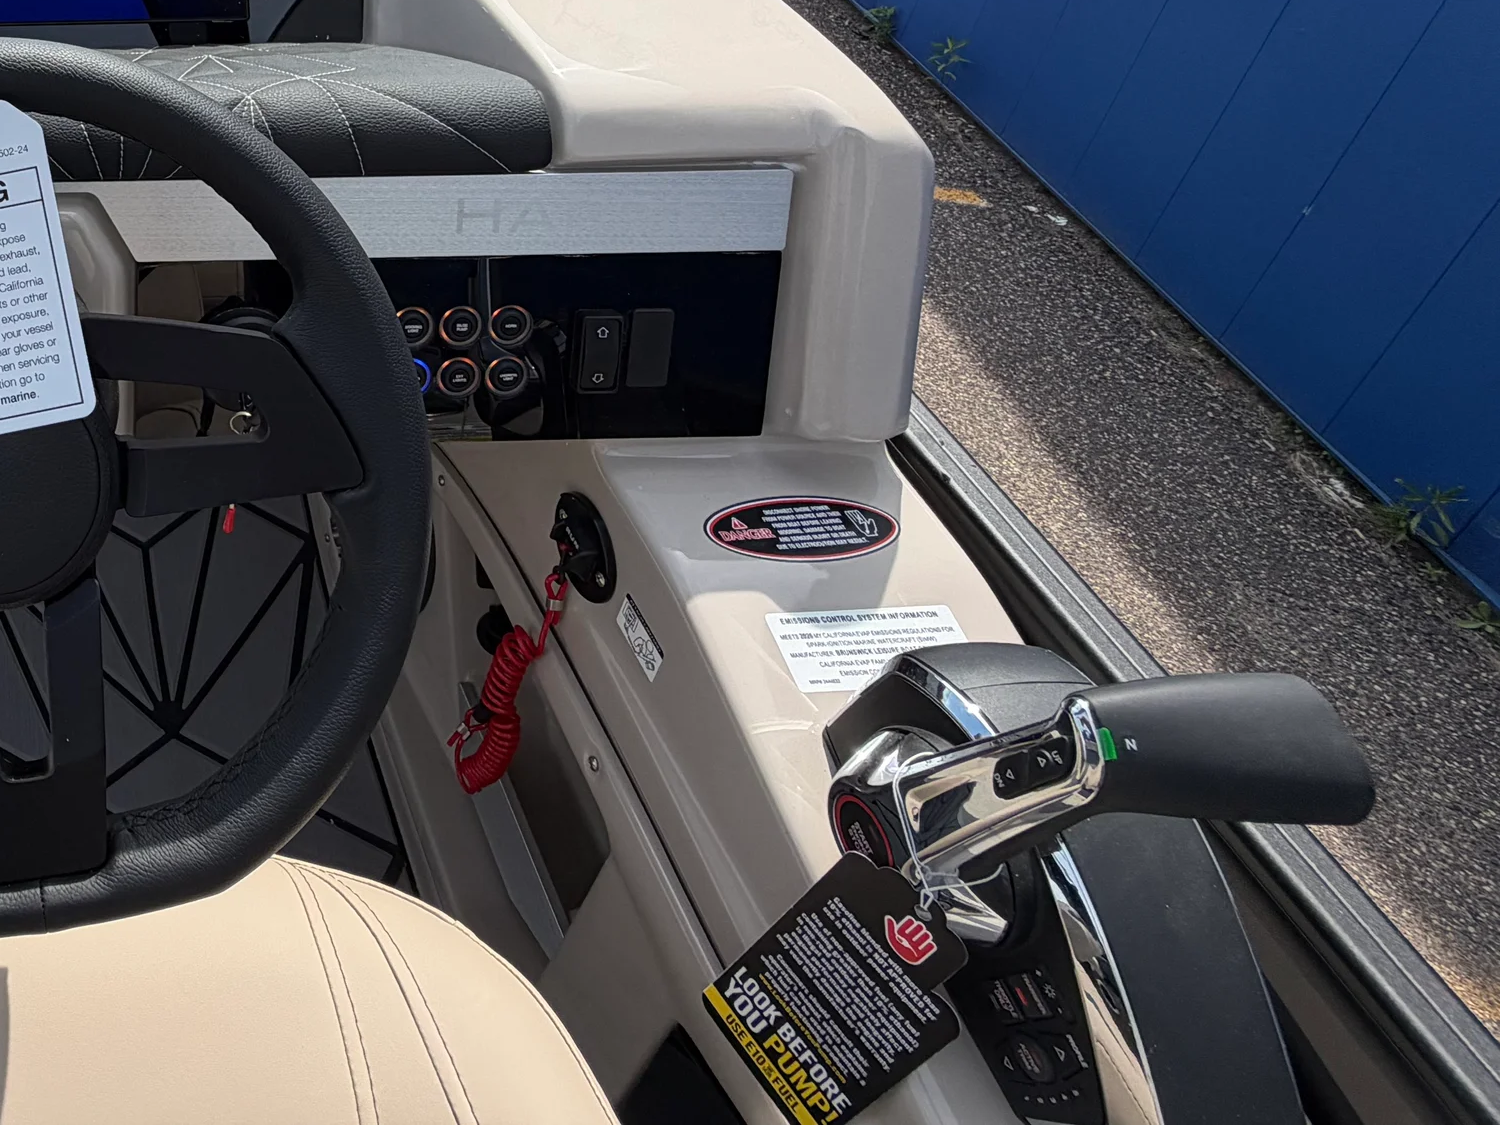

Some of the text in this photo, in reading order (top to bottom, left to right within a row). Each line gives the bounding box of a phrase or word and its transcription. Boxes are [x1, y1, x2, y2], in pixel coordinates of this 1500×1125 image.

[0, 246, 40, 262] exhaust,
[7, 263, 31, 276] lead,
[10, 298, 20, 307] or
[23, 292, 48, 304] other
[1, 308, 49, 324] exposure,
[1, 329, 22, 342] your
[24, 321, 54, 335] vessel
[13, 341, 45, 356] gloves
[46, 338, 57, 347] or
[18, 354, 60, 369] servicing
[19, 375, 33, 387] go
[34, 373, 45, 382] to
[718, 528, 776, 542] DANGER
[779, 610, 939, 625] EMISSIONS CONTROL SYSTEM INFORMATION
[835, 649, 873, 657] BRUNSWICK
[1124, 738, 1138, 751] N
[1051, 750, 1063, 766] UP
[734, 966, 852, 1115] LOOK BEFORE
[724, 977, 839, 1125] YOU PUMP!
[725, 1014, 799, 1113] USE E10 FUEL
